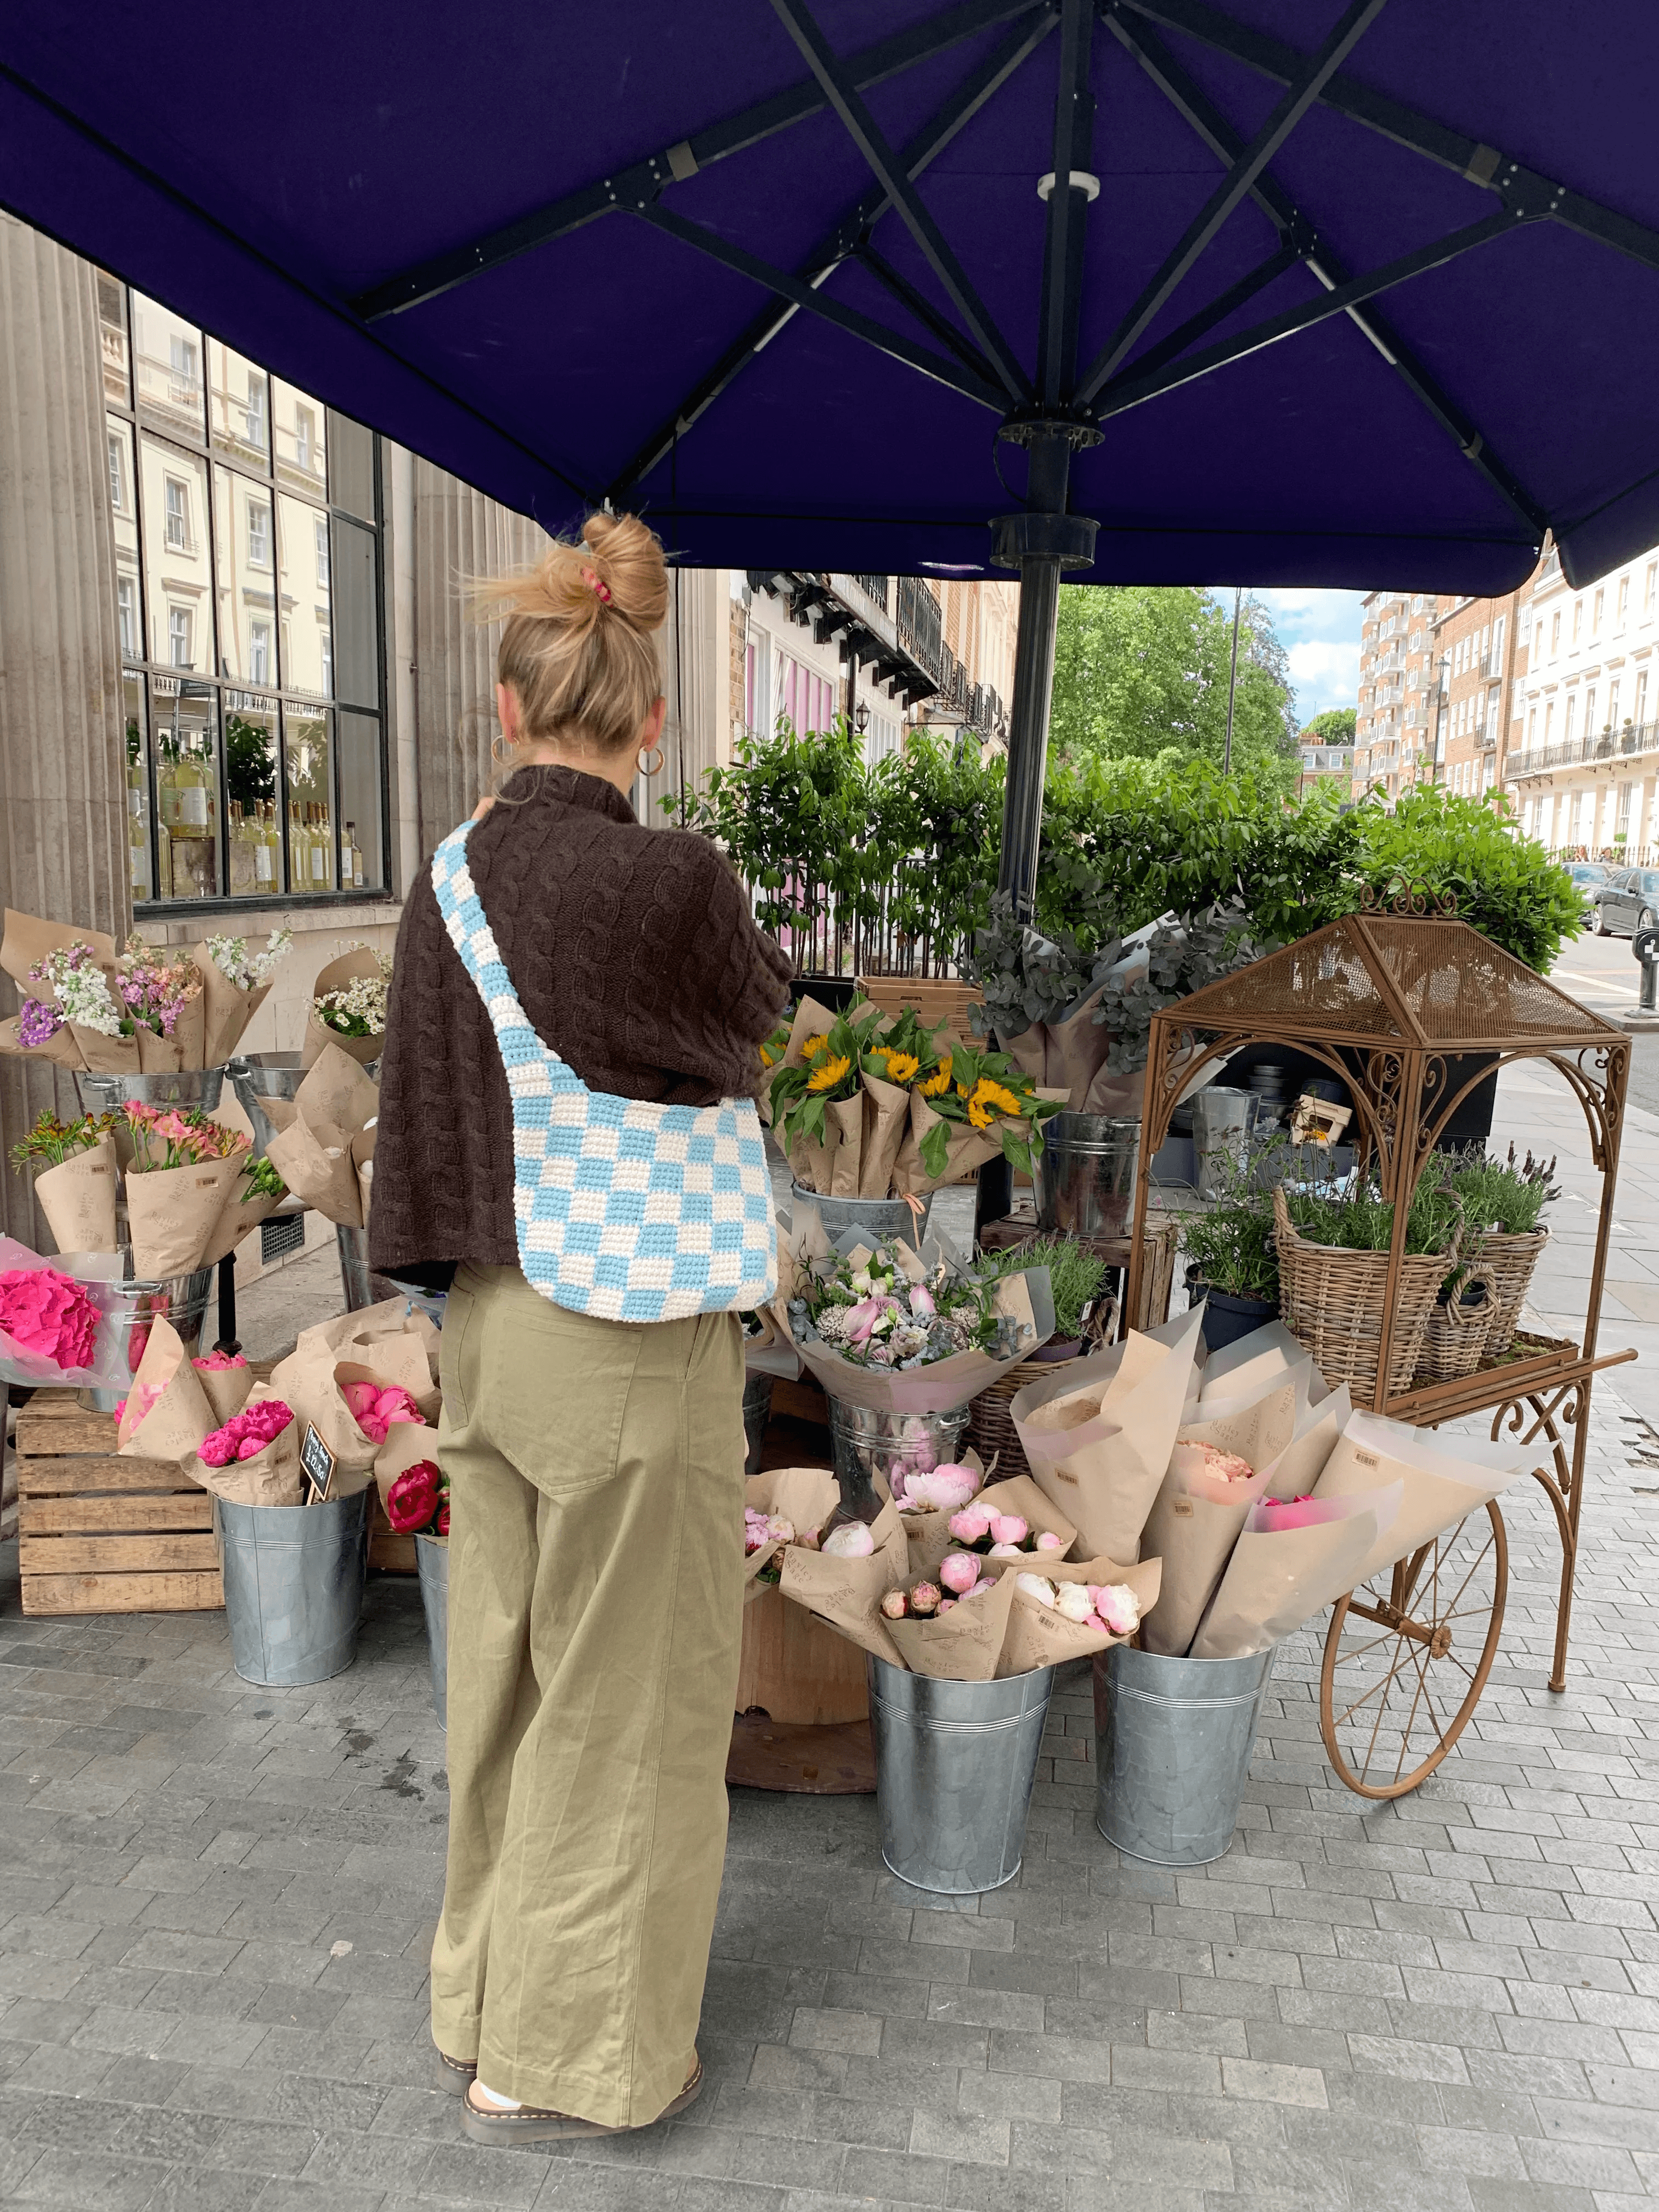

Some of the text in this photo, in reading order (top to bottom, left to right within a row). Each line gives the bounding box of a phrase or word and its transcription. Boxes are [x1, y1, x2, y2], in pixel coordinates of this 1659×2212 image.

[152, 1211, 180, 1227] Bayley
[1211, 1420, 1239, 1437] Bayley
[166, 1432, 195, 1447] Bayley
[1266, 1431, 1284, 1447] Bayley
[786, 1550, 814, 1582] Bayley
[825, 1587, 856, 1613] Bayley
[977, 1593, 985, 1611] ayley
[960, 1622, 995, 1634] Bayley
